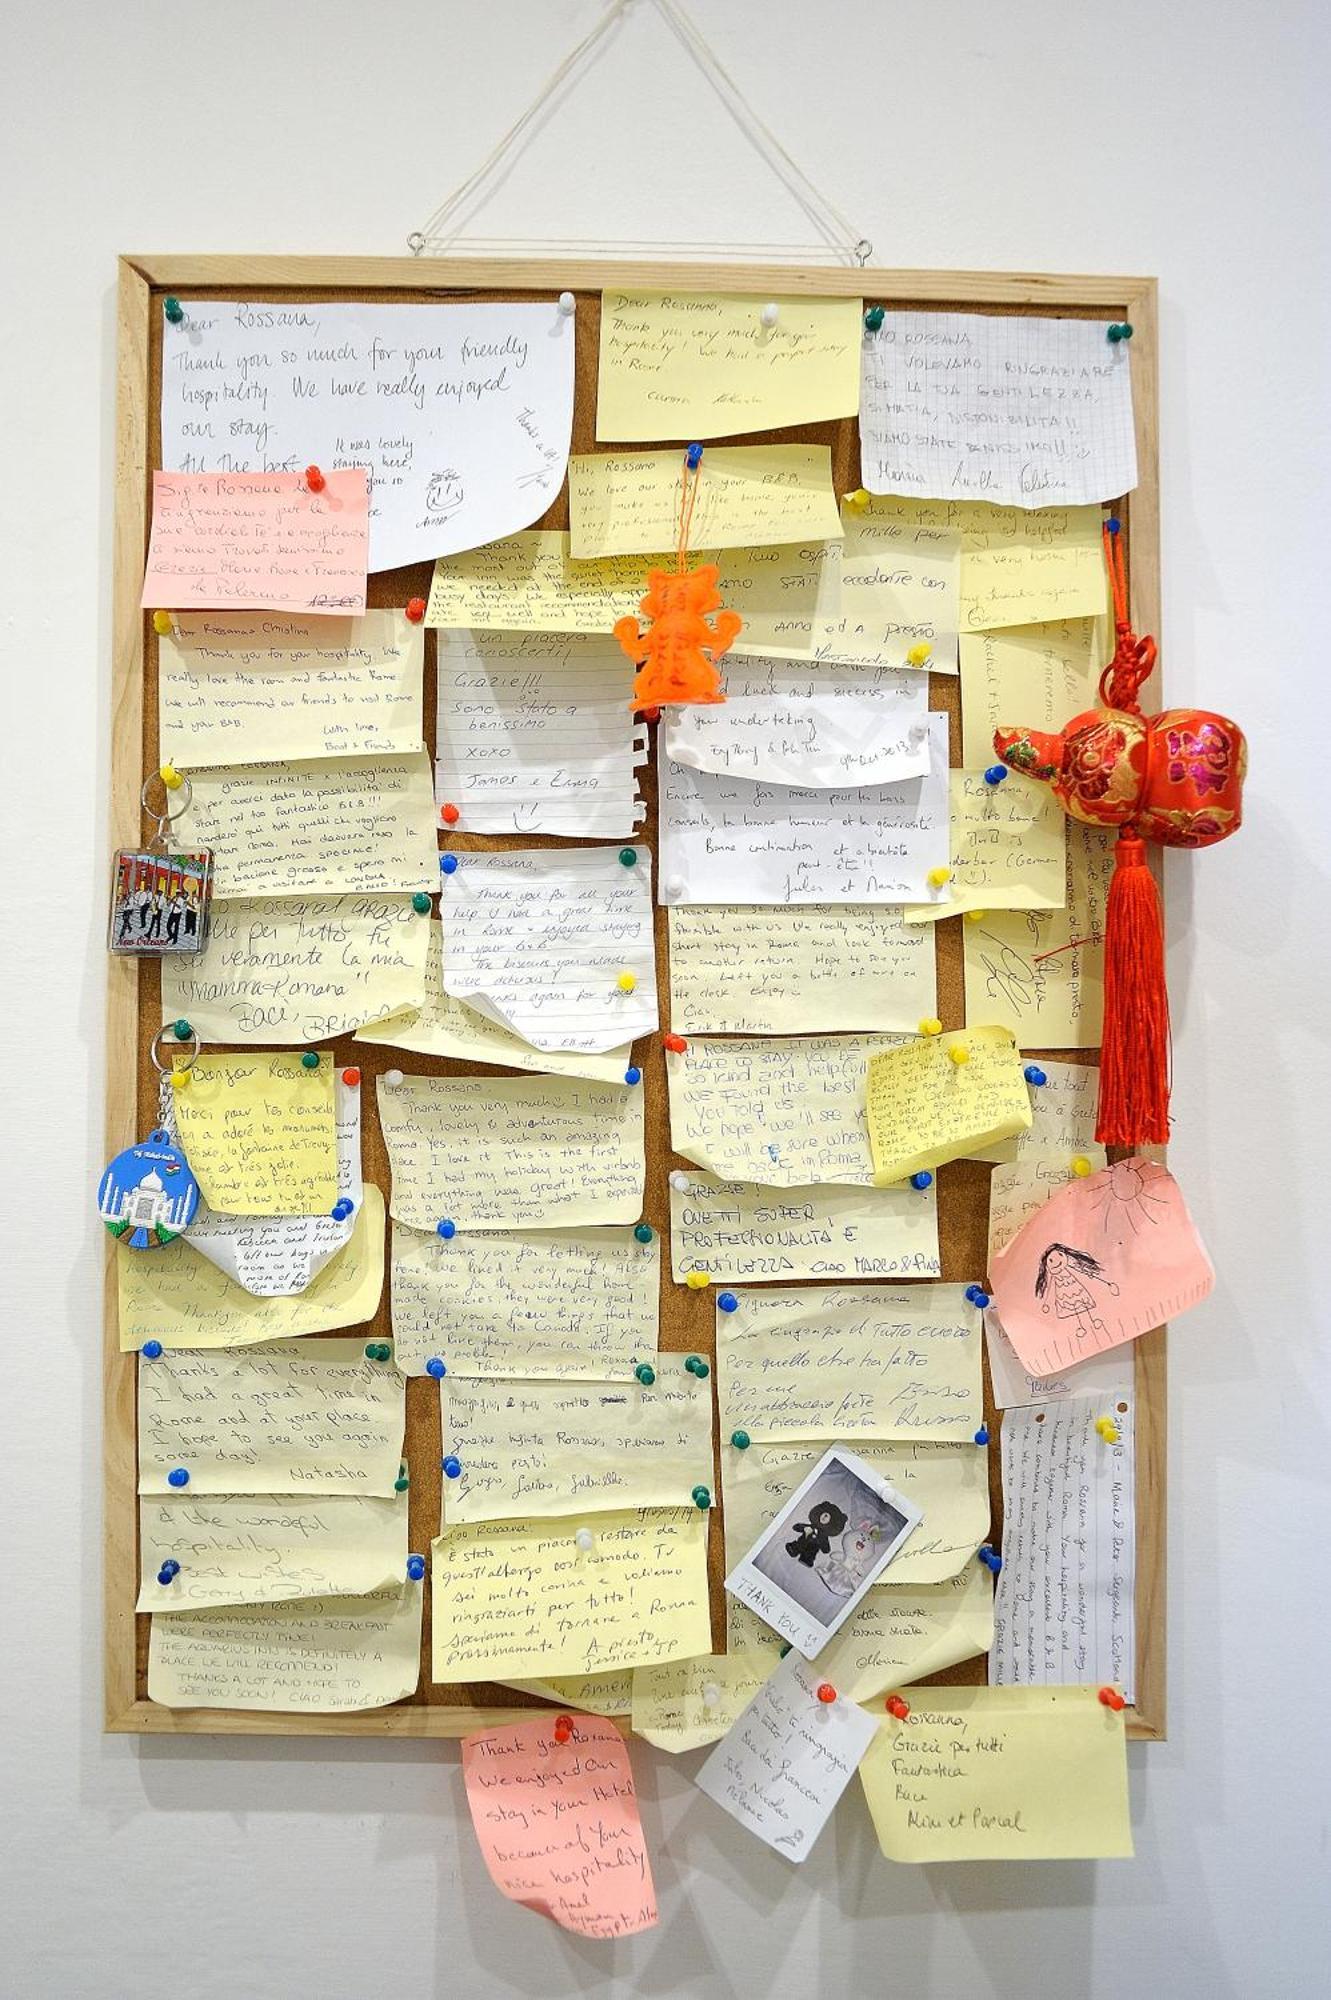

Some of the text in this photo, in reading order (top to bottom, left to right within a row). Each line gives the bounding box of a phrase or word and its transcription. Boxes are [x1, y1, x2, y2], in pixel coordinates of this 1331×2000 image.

[172, 335, 528, 381] Thank you so much for your friendly
[291, 376, 320, 399] We
[330, 378, 368, 399] have
[376, 373, 427, 410] really
[435, 366, 513, 404] enjoyed
[181, 424, 216, 438] our
[231, 1369, 244, 1377] a
[249, 1359, 280, 1377] lot
[178, 1385, 219, 1402] had
[231, 1391, 245, 1401] a
[250, 1381, 304, 1408] great
[218, 1408, 252, 1426] and
